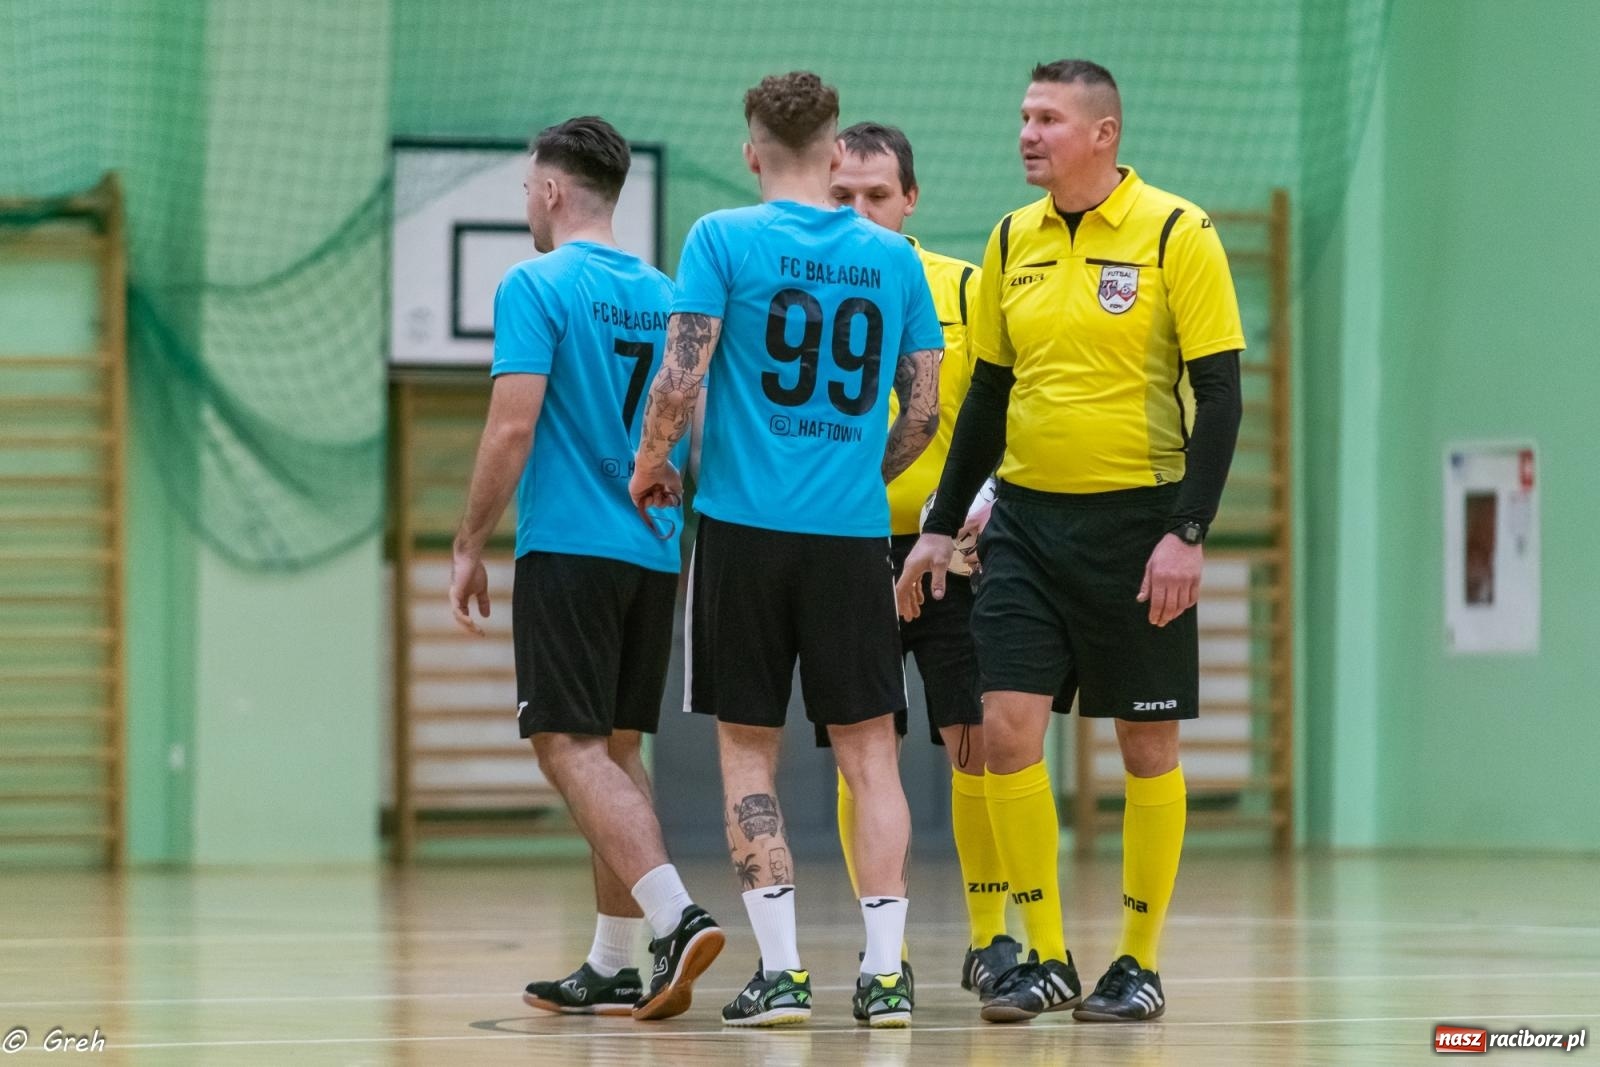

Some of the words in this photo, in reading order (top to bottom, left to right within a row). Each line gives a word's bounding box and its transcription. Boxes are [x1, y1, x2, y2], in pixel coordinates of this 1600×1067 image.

[780, 255, 801, 279] FC
[805, 259, 881, 290] BAŁAGAN
[591, 301, 610, 323] FC
[761, 287, 884, 417] 99
[614, 337, 654, 441] 7
